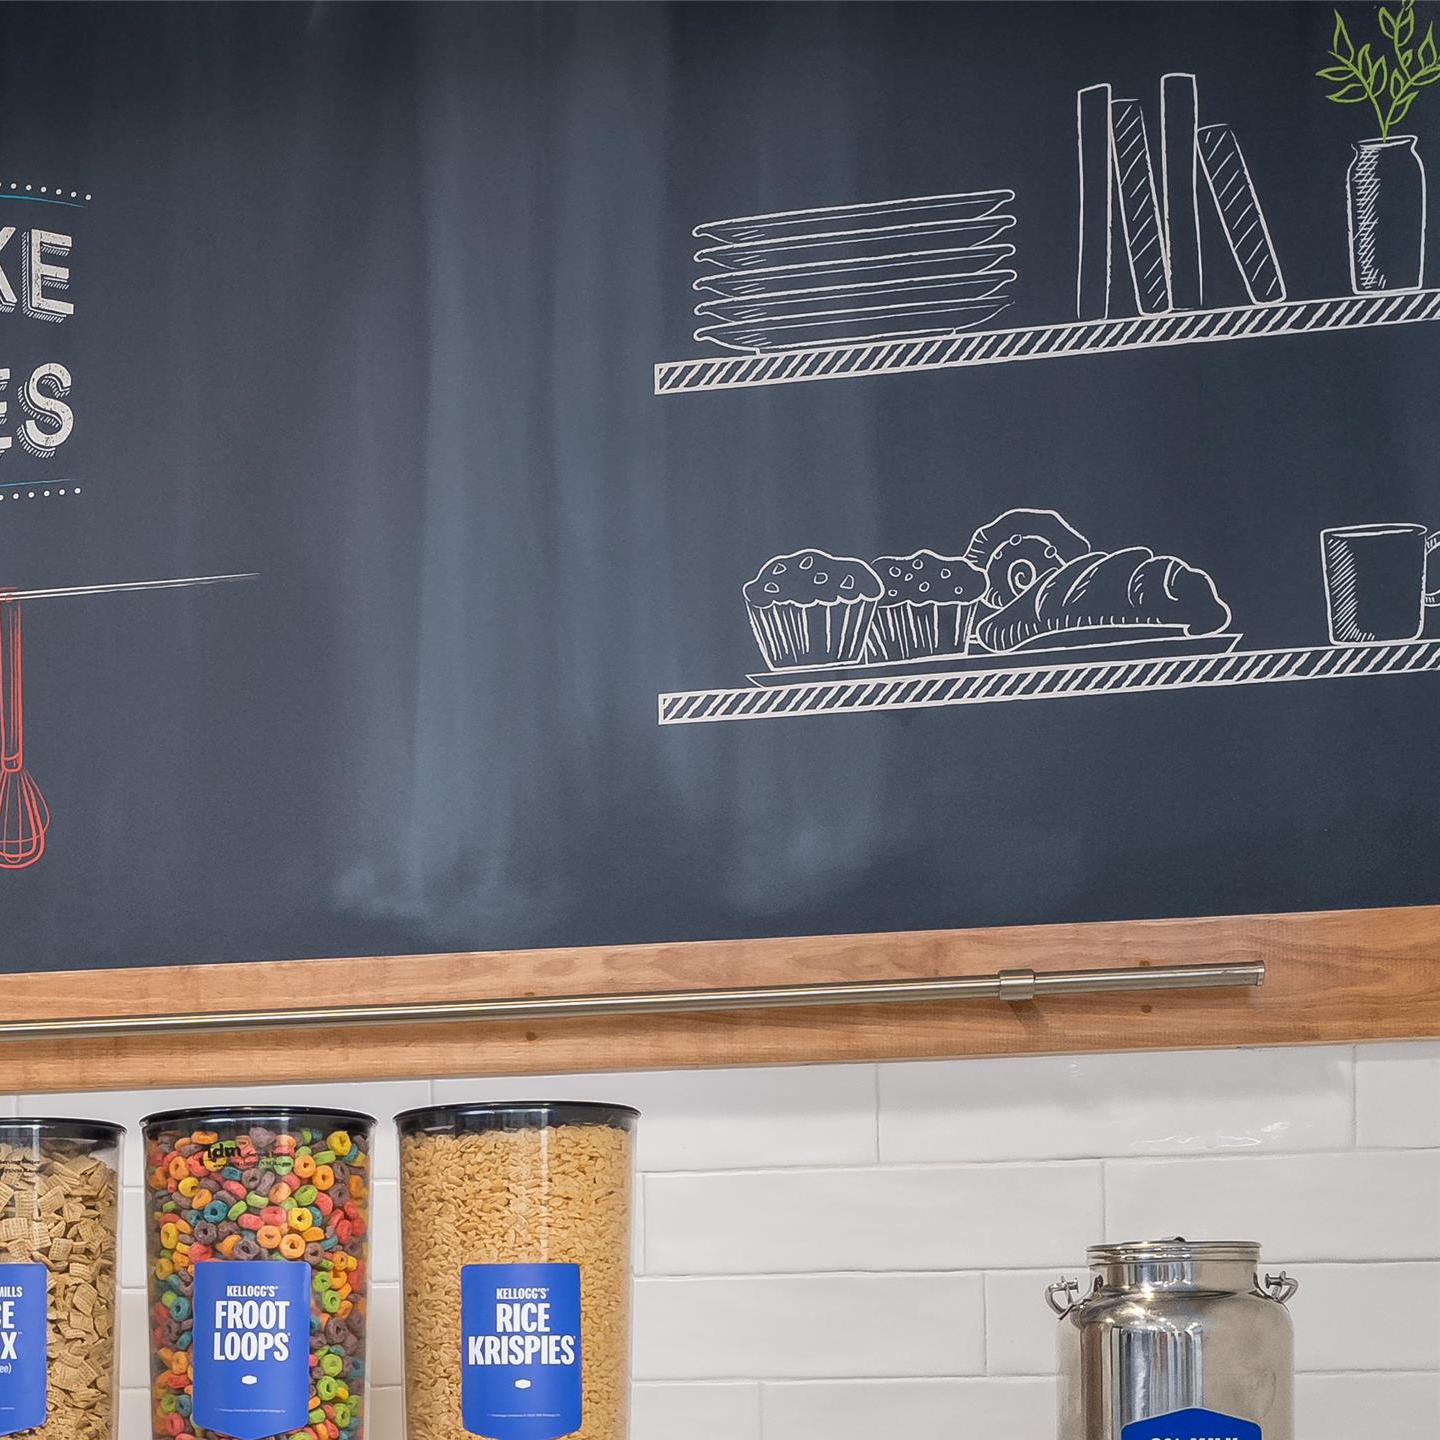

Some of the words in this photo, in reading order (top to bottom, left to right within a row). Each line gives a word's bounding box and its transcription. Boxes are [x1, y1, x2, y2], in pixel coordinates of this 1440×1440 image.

[215, 1300, 290, 1330] FROOT
[496, 1302, 551, 1332] RICE
[213, 1332, 290, 1361] LOOPS
[468, 1335, 576, 1365] KRISPIES
